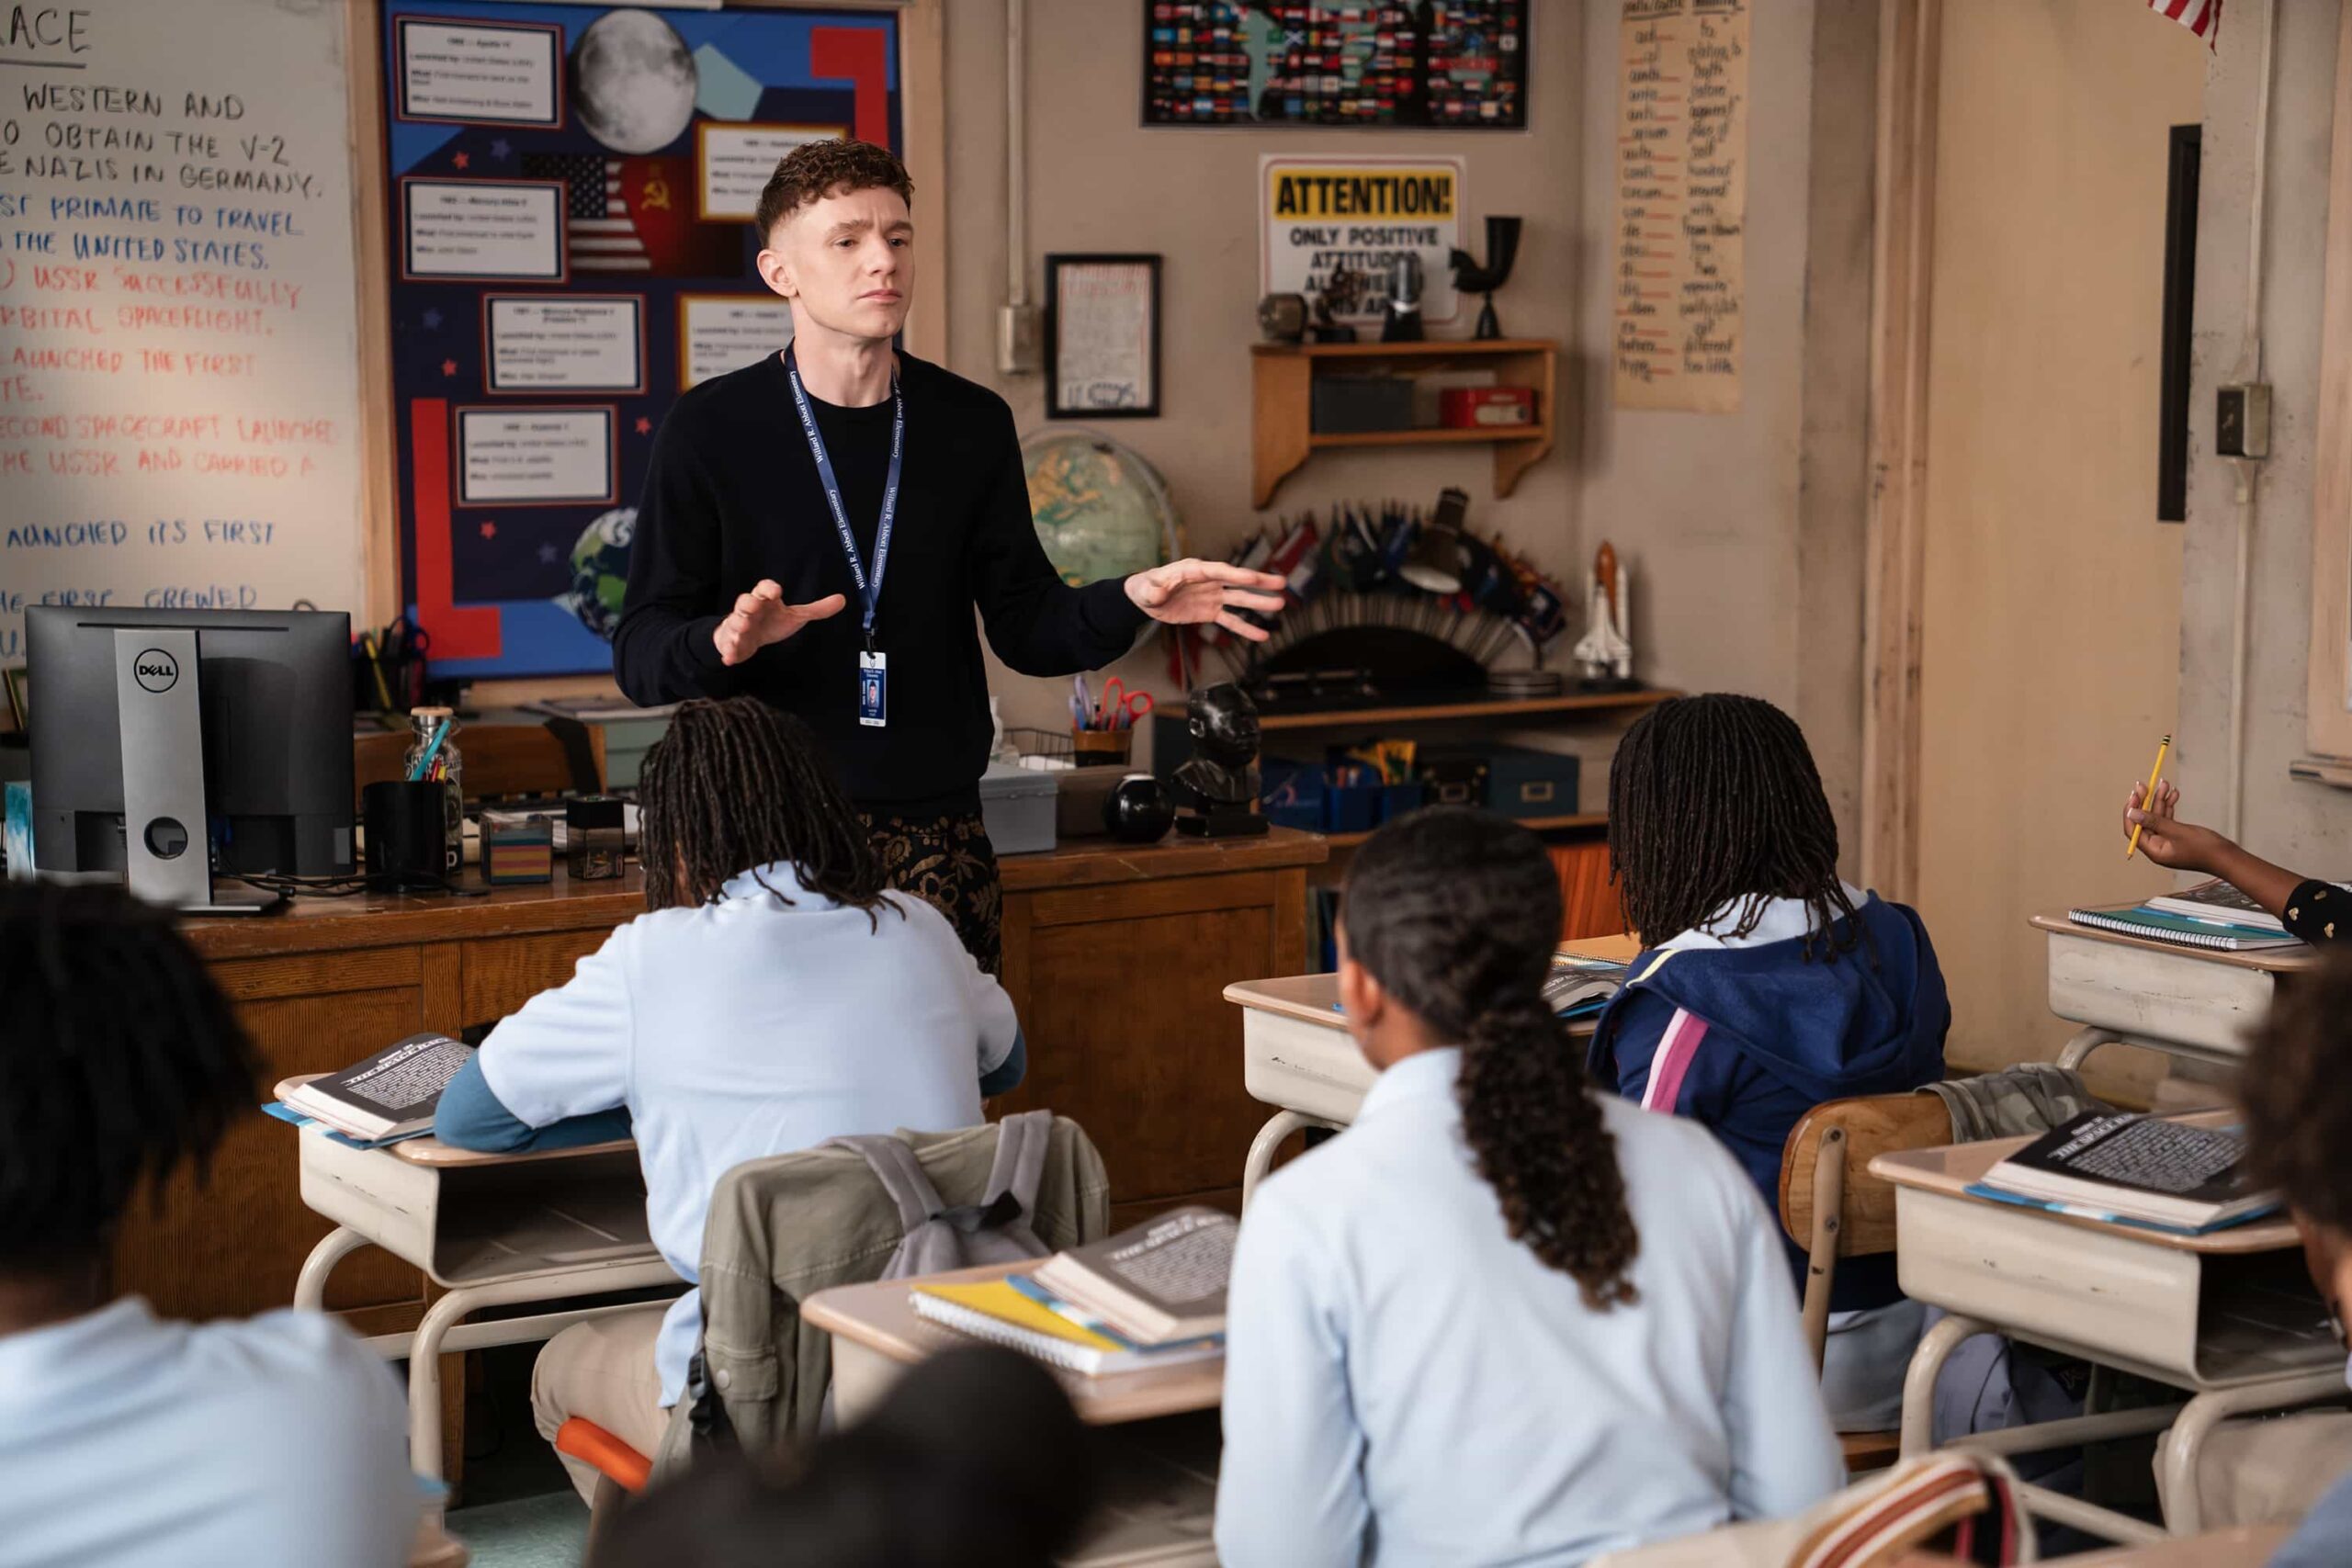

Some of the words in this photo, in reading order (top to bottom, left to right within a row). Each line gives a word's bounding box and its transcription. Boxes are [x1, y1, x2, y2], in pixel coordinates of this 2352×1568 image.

[0, 5, 91, 53] ACE
[24, 84, 162, 118] WESTERN
[184, 93, 244, 119] AND
[45, 122, 153, 152] OBTAIN
[165, 131, 219, 158] THE
[241, 135, 289, 166] V-2
[25, 156, 118, 182] NAZIS
[133, 161, 164, 183] IN
[179, 165, 323, 199] GERMANY.
[1276, 176, 1451, 214] ATTENTION!
[51, 196, 160, 222] PRIMATE
[176, 204, 202, 227] TO
[217, 208, 304, 235] TRAVEL
[15, 231, 57, 254] THE
[74, 234, 164, 261] UNITED
[175, 237, 269, 269] STATES.
[1290, 227, 1340, 247] ONLY
[1348, 226, 1439, 246] POSITIVE
[34, 265, 98, 291] USSR
[114, 265, 302, 310] SUCCESSFULLY
[0, 347, 123, 373] AUNCHED
[139, 348, 175, 372] THE
[185, 351, 256, 376] FIRST
[790, 371, 804, 404] Elementary
[75, 414, 220, 441] SPACECRAFT
[799, 404, 812, 426] Abbott
[808, 428, 816, 436] R.
[892, 420, 903, 458] Elementary
[49, 450, 120, 477] USSR
[139, 447, 181, 472] AND
[194, 454, 288, 478] CARRIED
[300, 454, 317, 478] A
[809, 437, 823, 463] Willard
[829, 489, 845, 529] Elementary
[886, 487, 896, 513] Willard
[884, 513, 892, 522] R.
[148, 519, 187, 546] ITS
[203, 521, 274, 546] FIRST
[841, 529, 854, 553] Abbott
[850, 554, 857, 563] R.
[871, 548, 887, 588] Elementary
[851, 563, 865, 589] Willard
[42, 588, 113, 607] FIRST
[144, 585, 257, 609] CREWED
[139, 665, 174, 676] DELL
